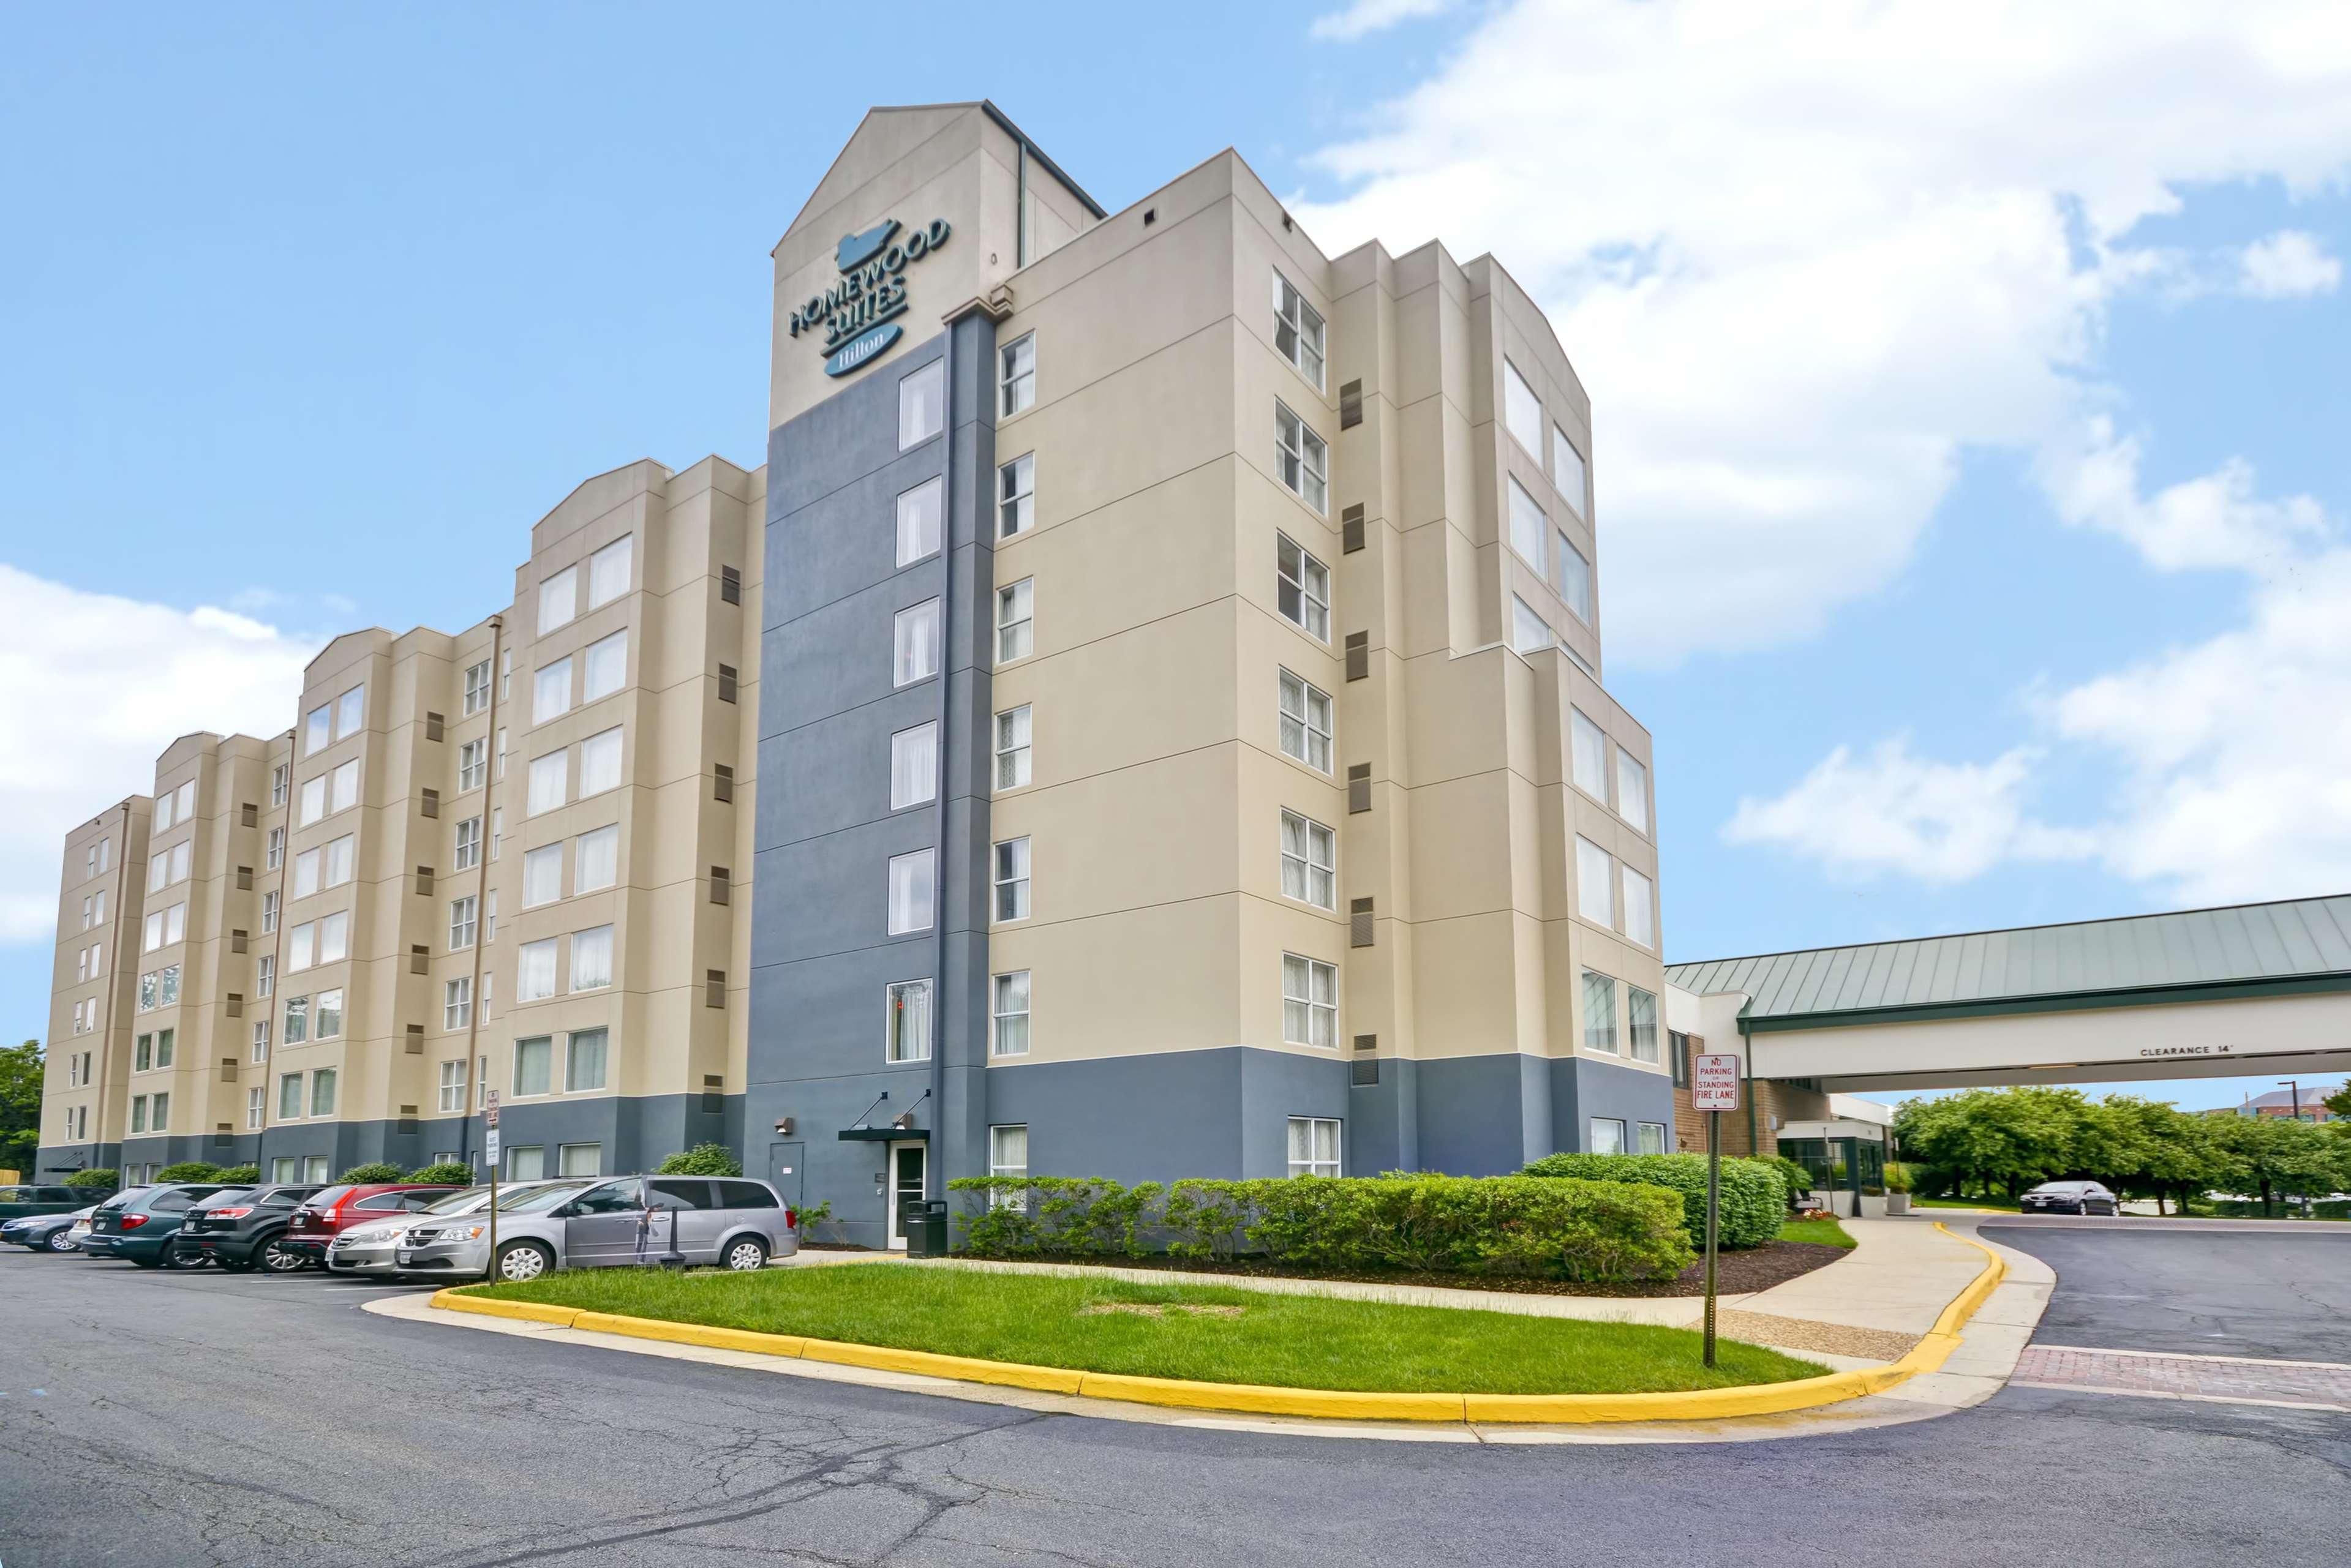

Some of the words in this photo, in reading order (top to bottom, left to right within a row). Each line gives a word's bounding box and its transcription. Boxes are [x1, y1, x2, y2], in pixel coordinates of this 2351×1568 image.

[789, 218, 951, 338] HOMEWOOD
[824, 276, 906, 345] SUITES
[839, 333, 884, 368] Hilton
[2140, 1046, 2210, 1056] CLEARANCE
[1697, 1090, 1712, 1099] FIRE
[1716, 1090, 1734, 1099] LANE
